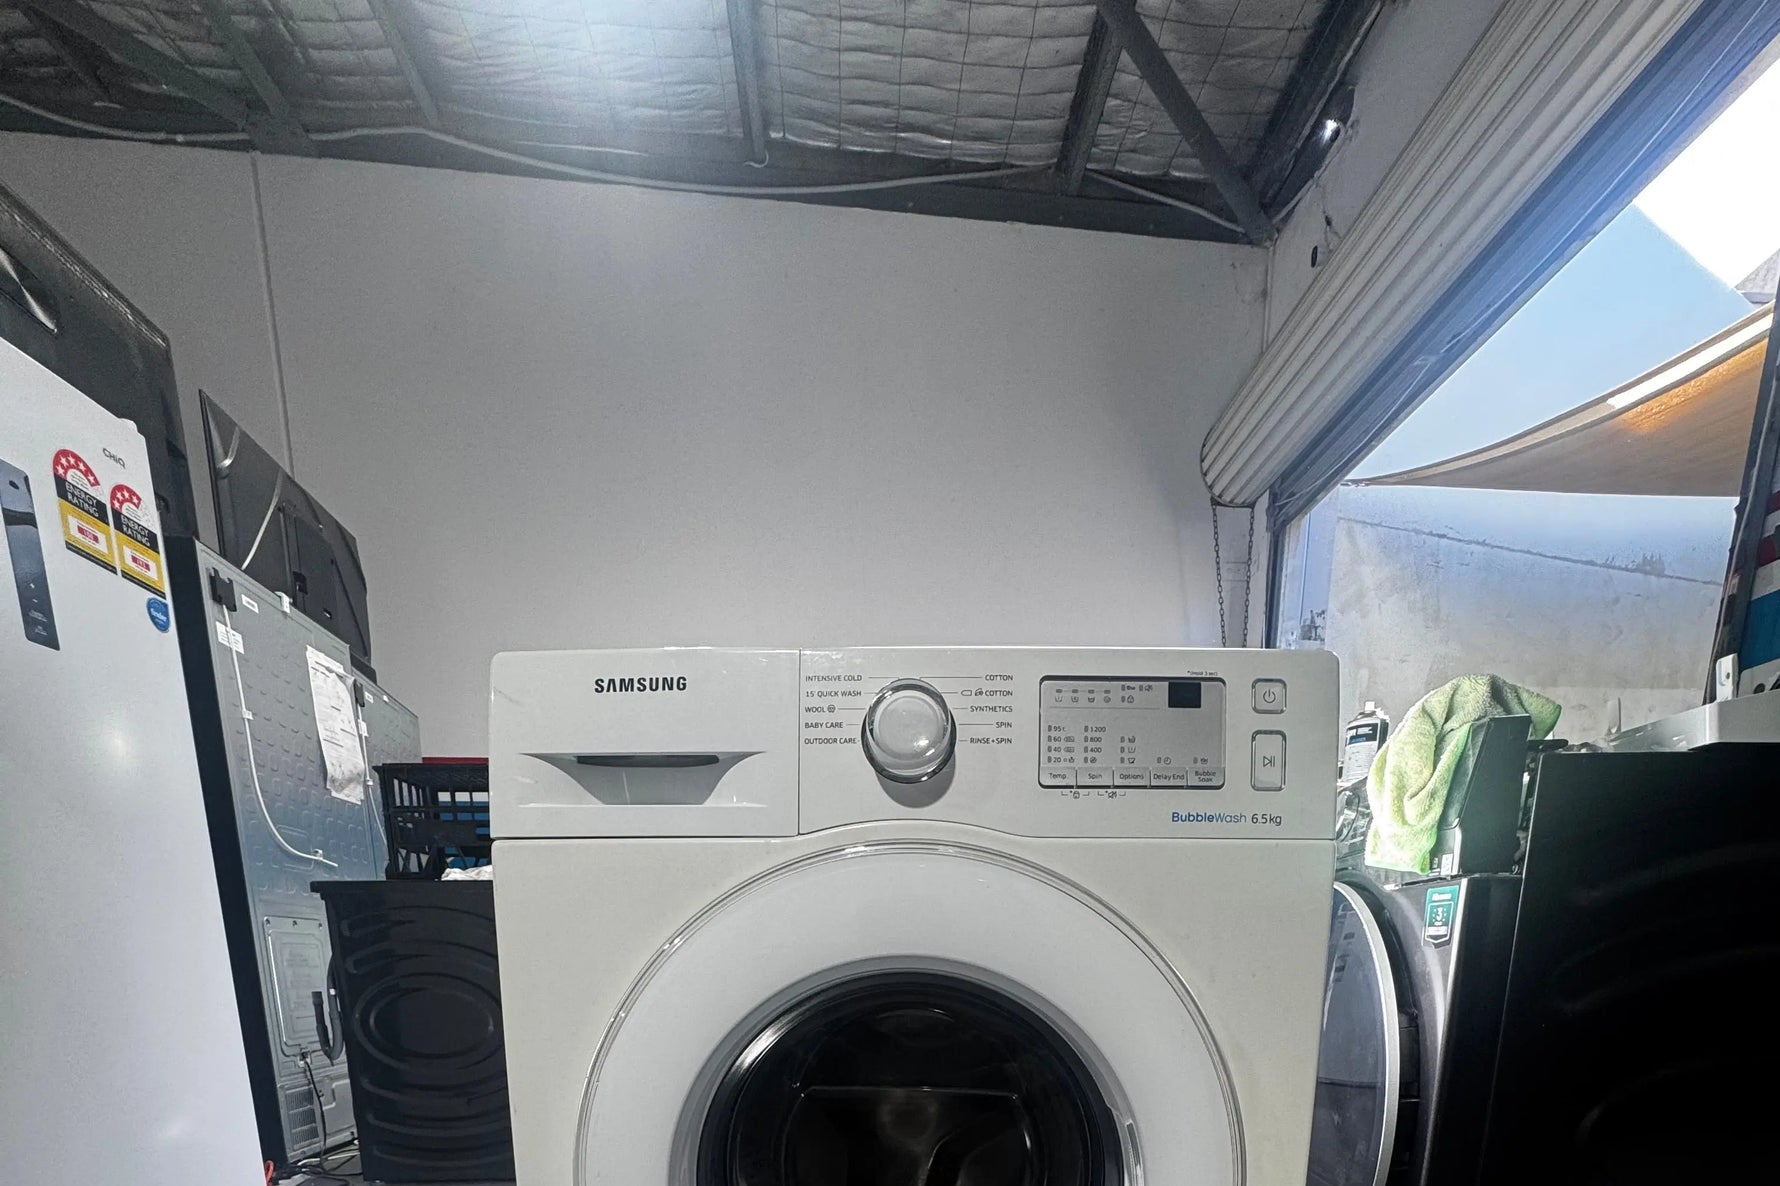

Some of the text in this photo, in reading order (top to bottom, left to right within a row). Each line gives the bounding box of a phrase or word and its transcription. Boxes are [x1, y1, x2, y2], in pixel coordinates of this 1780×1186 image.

[65, 480, 97, 507] ENERGY
[67, 494, 99, 517] RATING
[121, 514, 149, 537] ENERGY
[123, 525, 151, 547] RATING
[805, 674, 863, 682] INTENSIVE COLD
[594, 676, 687, 693] SAMSUNG
[984, 689, 1013, 697] COTTON
[970, 705, 1013, 713] SYNTHETICS
[804, 737, 857, 745] OUTDOOR CARE
[969, 737, 990, 745] RINSE
[1119, 773, 1144, 781] Options
[1152, 773, 1172, 781] Delay
[1171, 811, 1282, 826] BubbleWash 6.5kg
